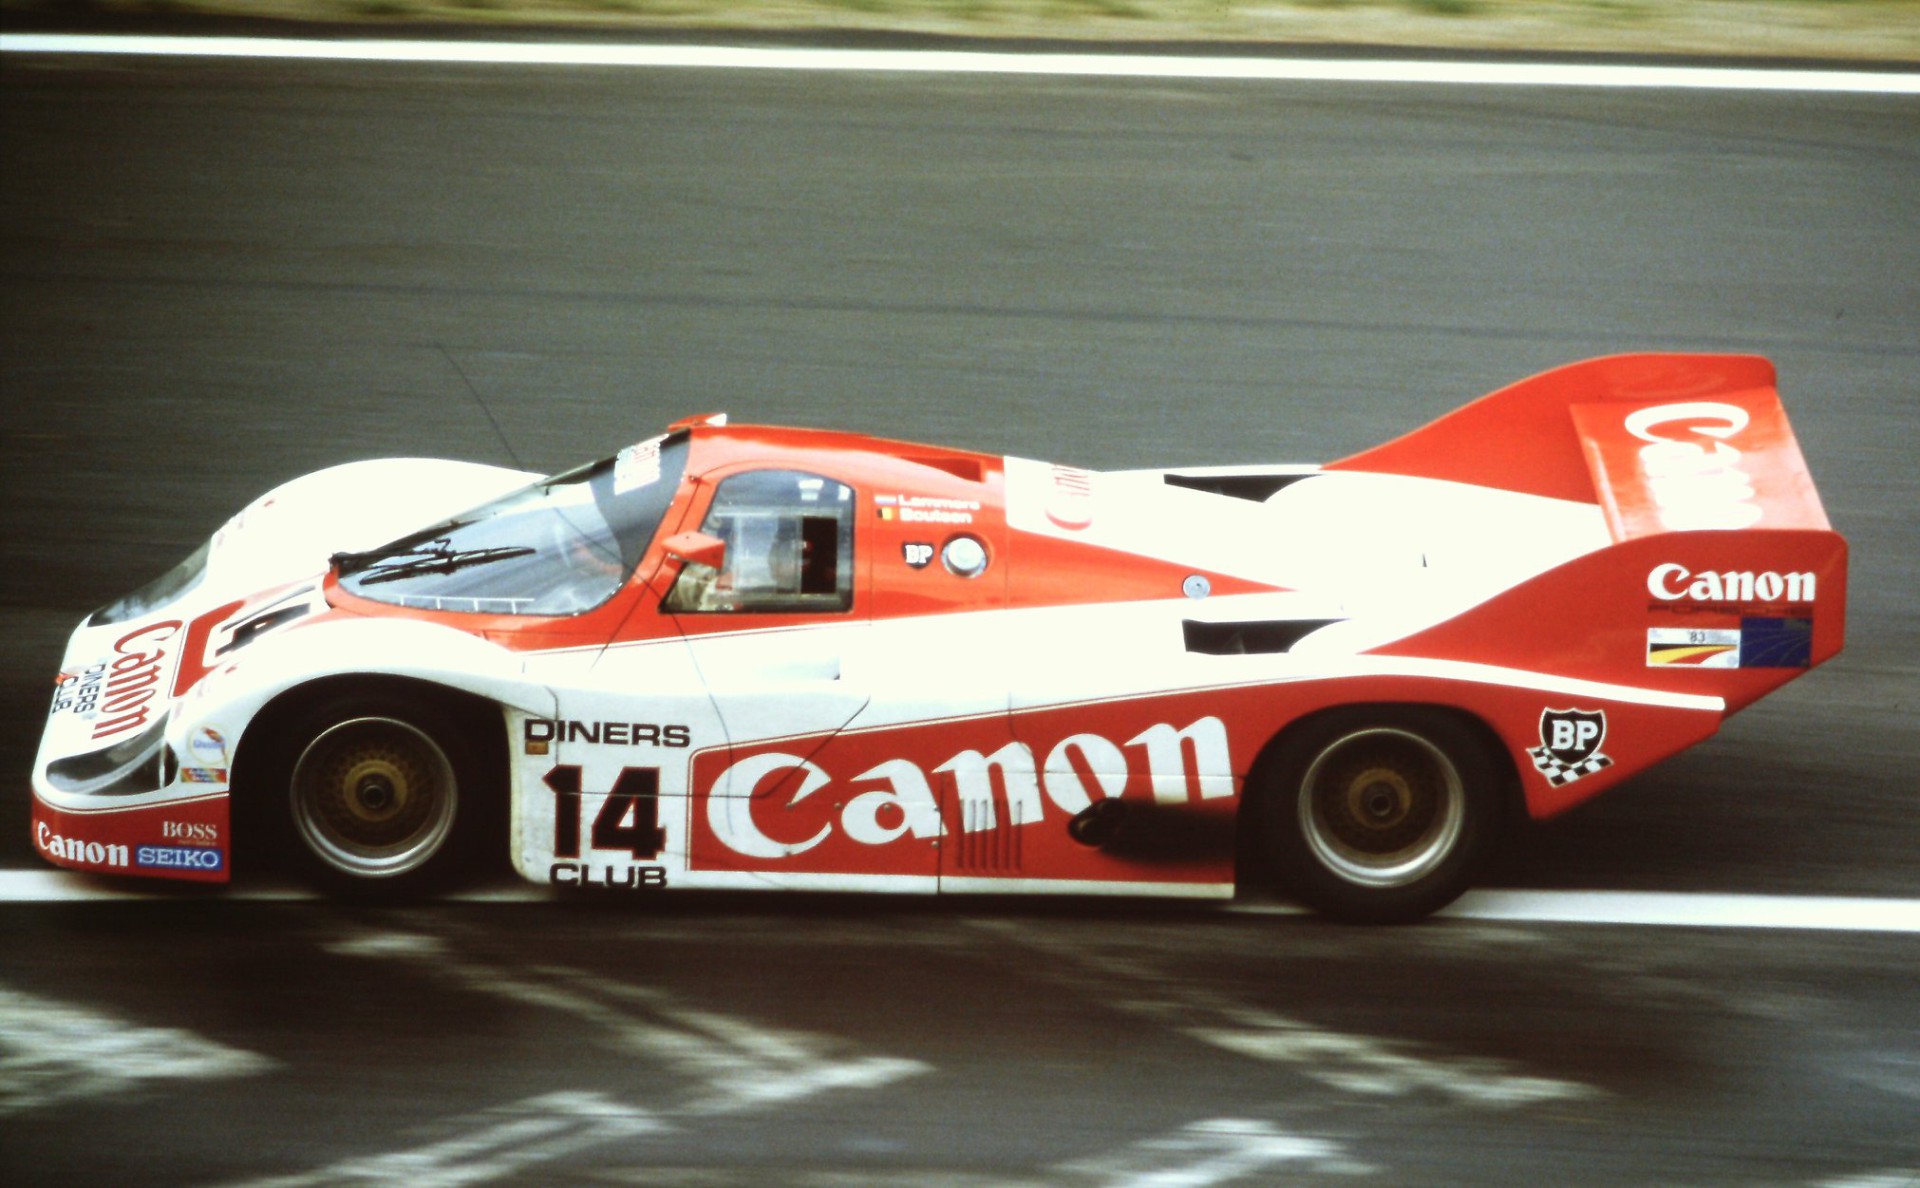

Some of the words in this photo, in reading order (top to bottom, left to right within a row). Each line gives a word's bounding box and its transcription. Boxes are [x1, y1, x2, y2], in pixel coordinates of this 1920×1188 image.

[904, 544, 933, 564] BP
[1647, 563, 1816, 602] Canon
[52, 674, 79, 715] CLUB
[74, 663, 106, 714] DINERS
[91, 619, 184, 740] Canon
[524, 718, 691, 748] DINERS
[1551, 720, 1599, 751] BP
[707, 715, 1235, 859] Canon
[162, 820, 218, 840] BOSS
[542, 764, 667, 861] 14
[38, 821, 129, 867] Canon
[138, 847, 219, 868] SEIKO
[550, 862, 668, 888] CLUB
